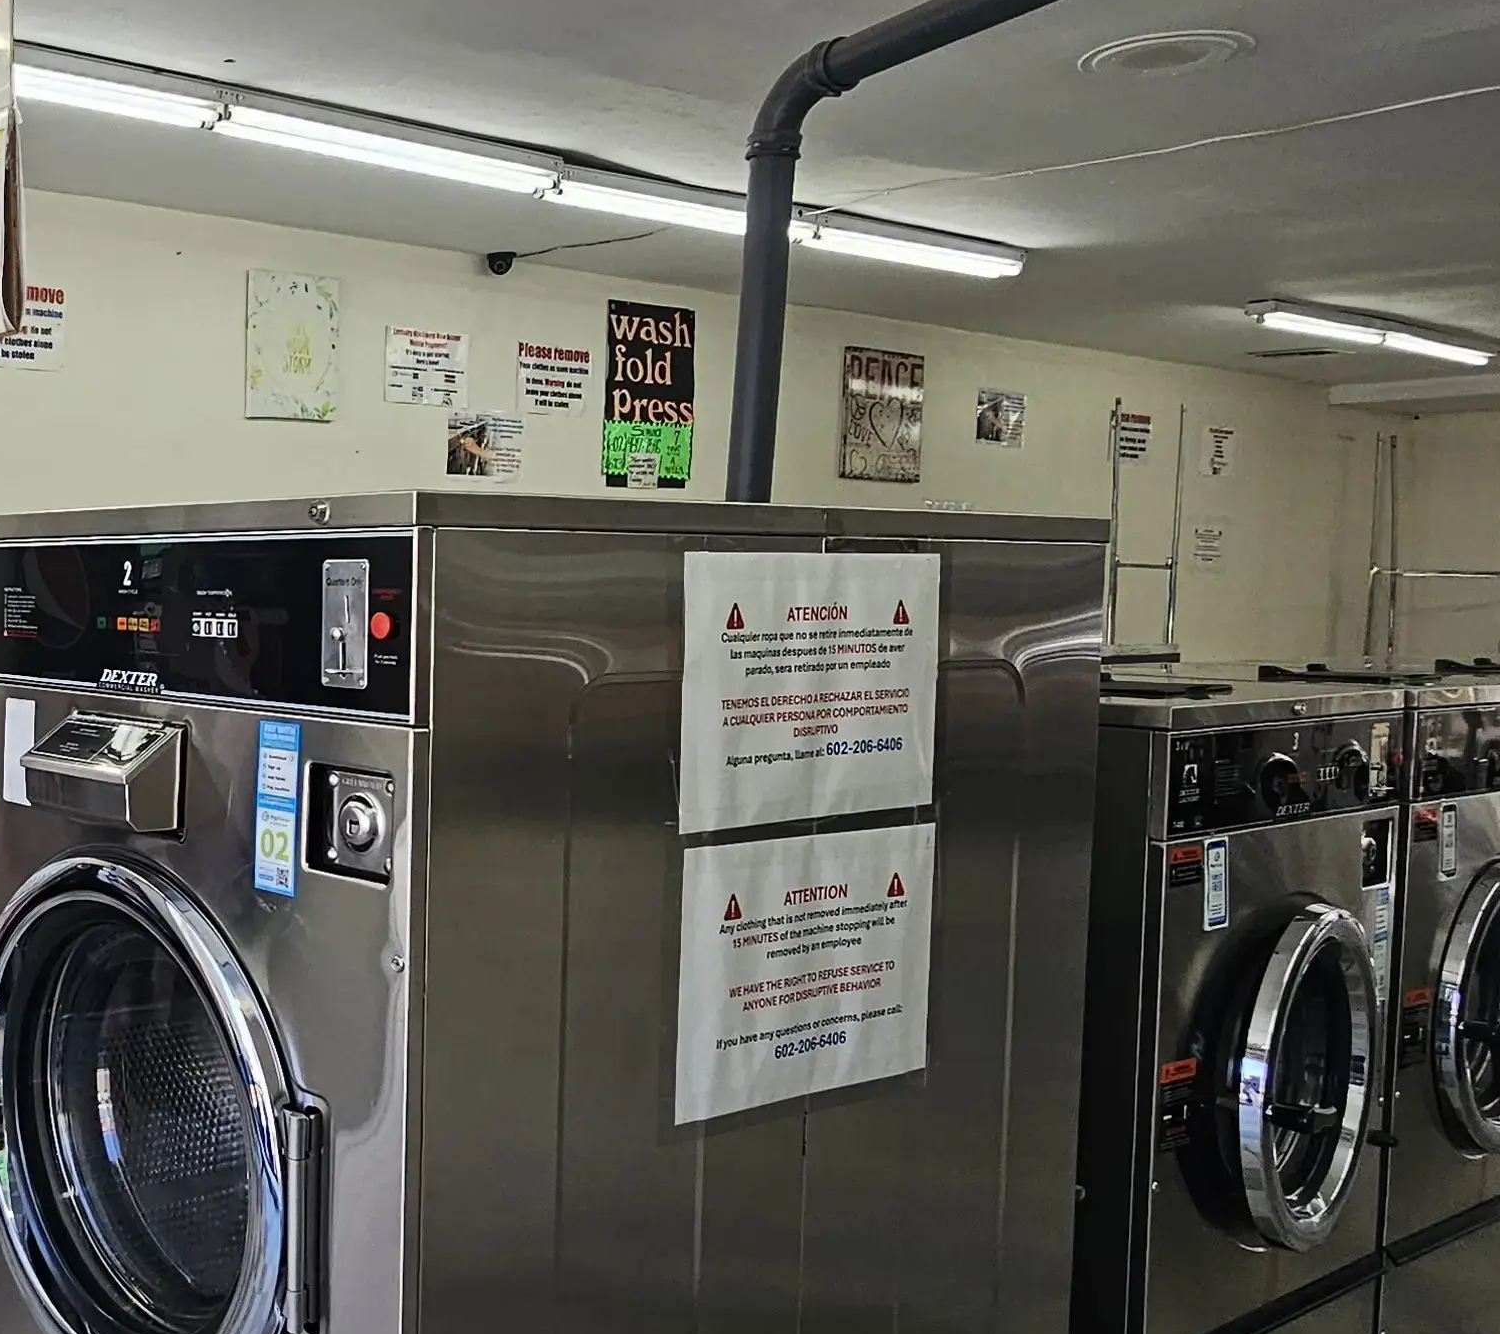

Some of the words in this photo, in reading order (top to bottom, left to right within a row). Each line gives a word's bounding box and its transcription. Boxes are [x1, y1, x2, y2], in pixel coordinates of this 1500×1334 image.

[610, 311, 692, 348] wash
[518, 341, 552, 360] Please
[553, 347, 590, 364] remove
[614, 344, 672, 385] fold
[122, 560, 133, 586] 2
[786, 602, 848, 623] ATENCIÓN
[721, 631, 761, 644] Cualquier
[761, 633, 778, 643] ropa
[779, 632, 794, 642] que
[795, 632, 807, 640] no
[808, 631, 818, 640] se
[819, 629, 837, 639] retire
[838, 628, 903, 639] inmediatamente
[904, 627, 913, 637] de
[744, 648, 781, 660] maquinas
[782, 646, 817, 658] despues
[818, 646, 827, 655] de
[829, 645, 836, 655] 15
[837, 643, 877, 654] MINUTOS
[878, 643, 888, 653] de
[889, 644, 906, 653] aver
[100, 668, 158, 687] DEXTER
[745, 664, 774, 678] parado,
[775, 665, 792, 674] sera
[794, 661, 824, 673] retirado
[825, 662, 837, 673] por
[838, 662, 849, 670] un
[850, 659, 891, 671] empleado
[98, 681, 134, 692] COMMERCIAL
[135, 684, 159, 694] WASHER
[721, 696, 760, 710] TENEMOS
[760, 696, 770, 707] EL
[771, 694, 813, 706] DERECHO
[813, 693, 818, 703] A
[819, 691, 863, 703] RECHAZAR
[864, 691, 873, 701] EL
[875, 688, 910, 700] SERVICIO
[722, 717, 729, 727] A
[730, 712, 775, 726] CUALQUIER
[776, 710, 815, 722] PERSONA
[816, 708, 831, 719] POR
[832, 703, 908, 718] COMPORTAMIENTO
[793, 723, 838, 738] DISRUPTIVO
[1292, 731, 1300, 751] 3
[726, 755, 753, 768] Alguna
[754, 751, 794, 765] pregunta,
[826, 736, 903, 756] 602-206-6406
[1276, 802, 1311, 816] DEXTER
[260, 828, 289, 862] 02
[783, 883, 848, 907] ATTENTION
[719, 924, 735, 935] Any
[736, 918, 767, 932] clothing
[767, 916, 785, 926] that
[786, 914, 793, 924] is
[794, 912, 806, 923] not
[806, 907, 840, 920] removed
[841, 901, 889, 916] immediately
[889, 899, 908, 909] after
[732, 938, 742, 948] 15
[742, 932, 779, 947] MINUTES
[780, 930, 789, 941] of
[789, 928, 801, 939] the
[802, 924, 834, 937] machine
[835, 919, 871, 932] stopping
[871, 916, 884, 927] will
[885, 916, 895, 925] be
[766, 943, 801, 959] removed
[802, 942, 810, 954] by
[811, 941, 820, 951] an
[821, 937, 862, 949] employee
[729, 986, 742, 998] WE
[743, 982, 765, 996] HAVE
[766, 979, 783, 991] THE
[784, 974, 807, 988] RIGHT
[807, 972, 817, 983] TO
[818, 967, 849, 981] REFUSE
[850, 961, 884, 976] SERVICE
[885, 960, 895, 971] TO
[743, 996, 778, 1012] ANYONE
[779, 992, 795, 1005] FOR
[795, 983, 839, 1002] DISRUPTIVE
[840, 977, 882, 993] BEHAVIOR
[716, 1039, 723, 1050] If
[723, 1038, 738, 1051] you
[739, 1033, 758, 1045] have
[759, 1030, 775, 1041] any
[775, 1022, 812, 1039] questions
[812, 1020, 820, 1029] or
[821, 1013, 860, 1027] concerns,
[861, 1008, 886, 1022] please
[774, 1030, 847, 1059] 602-206-6406
